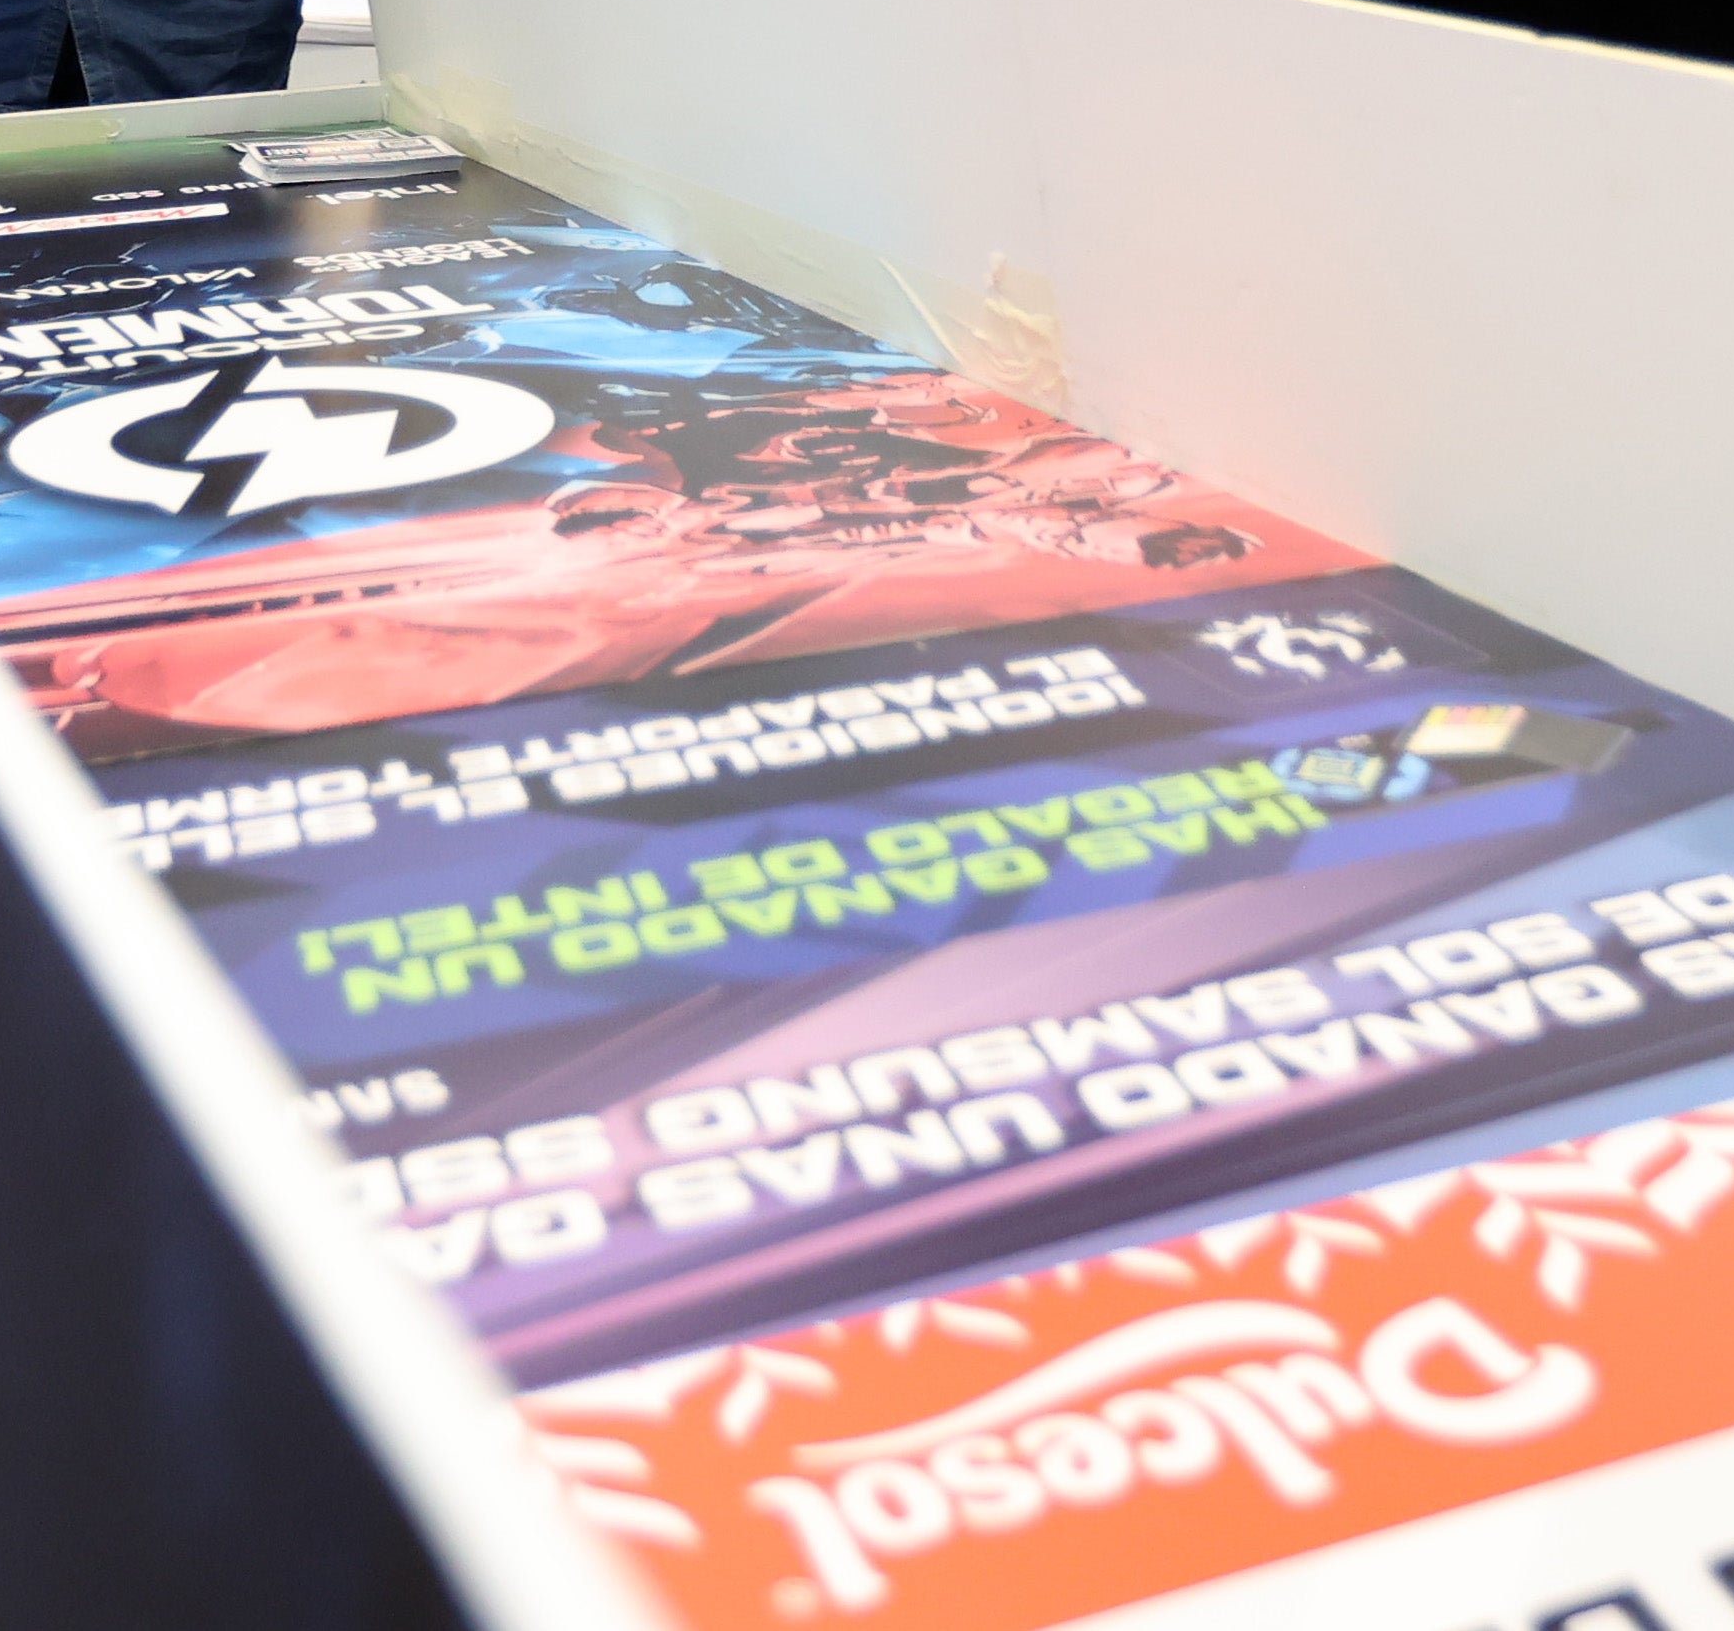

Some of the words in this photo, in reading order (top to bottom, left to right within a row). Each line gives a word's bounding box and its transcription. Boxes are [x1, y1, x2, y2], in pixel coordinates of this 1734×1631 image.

[1003, 646, 1121, 687] EL
[449, 667, 1000, 784] PASAPORTE
[398, 773, 531, 824] EL
[865, 759, 1290, 867] REGALO
[550, 844, 1052, 975] GANADO
[689, 837, 848, 903] DE
[340, 939, 526, 1015] UN
[1335, 912, 1595, 998] SOL
[644, 967, 1333, 1149] SAMSUNG
[1077, 963, 1645, 1134] GANADO
[636, 1091, 1066, 1230] UNAS
[745, 1295, 1598, 1610] Dulcesol
